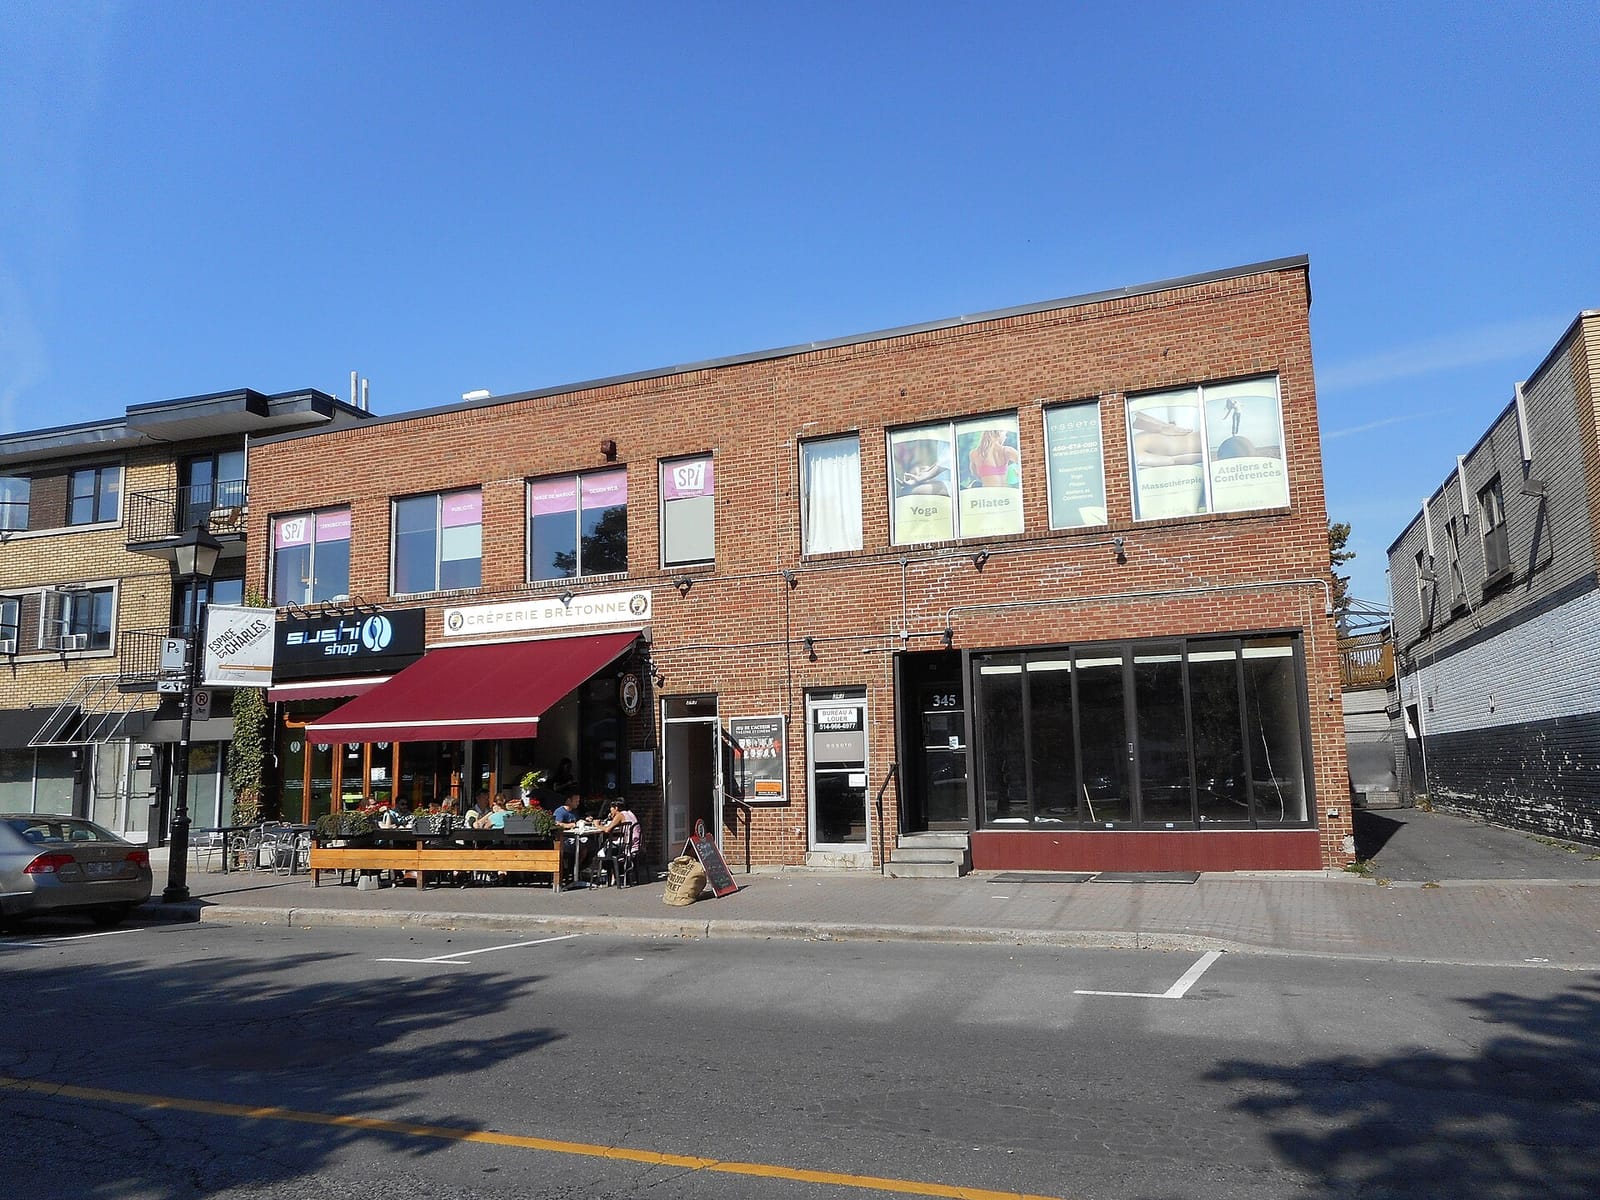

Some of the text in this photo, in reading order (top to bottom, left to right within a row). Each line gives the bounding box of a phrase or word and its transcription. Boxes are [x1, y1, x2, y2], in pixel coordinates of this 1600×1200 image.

[1217, 461, 1273, 475] Ateliers et
[970, 497, 1010, 509] Pilates
[910, 506, 938, 517] Yoga
[224, 619, 267, 655] CHARLES
[286, 620, 361, 645] sushi
[208, 627, 238, 653] ESPACE
[324, 642, 358, 656] shop
[932, 694, 956, 707] 345
